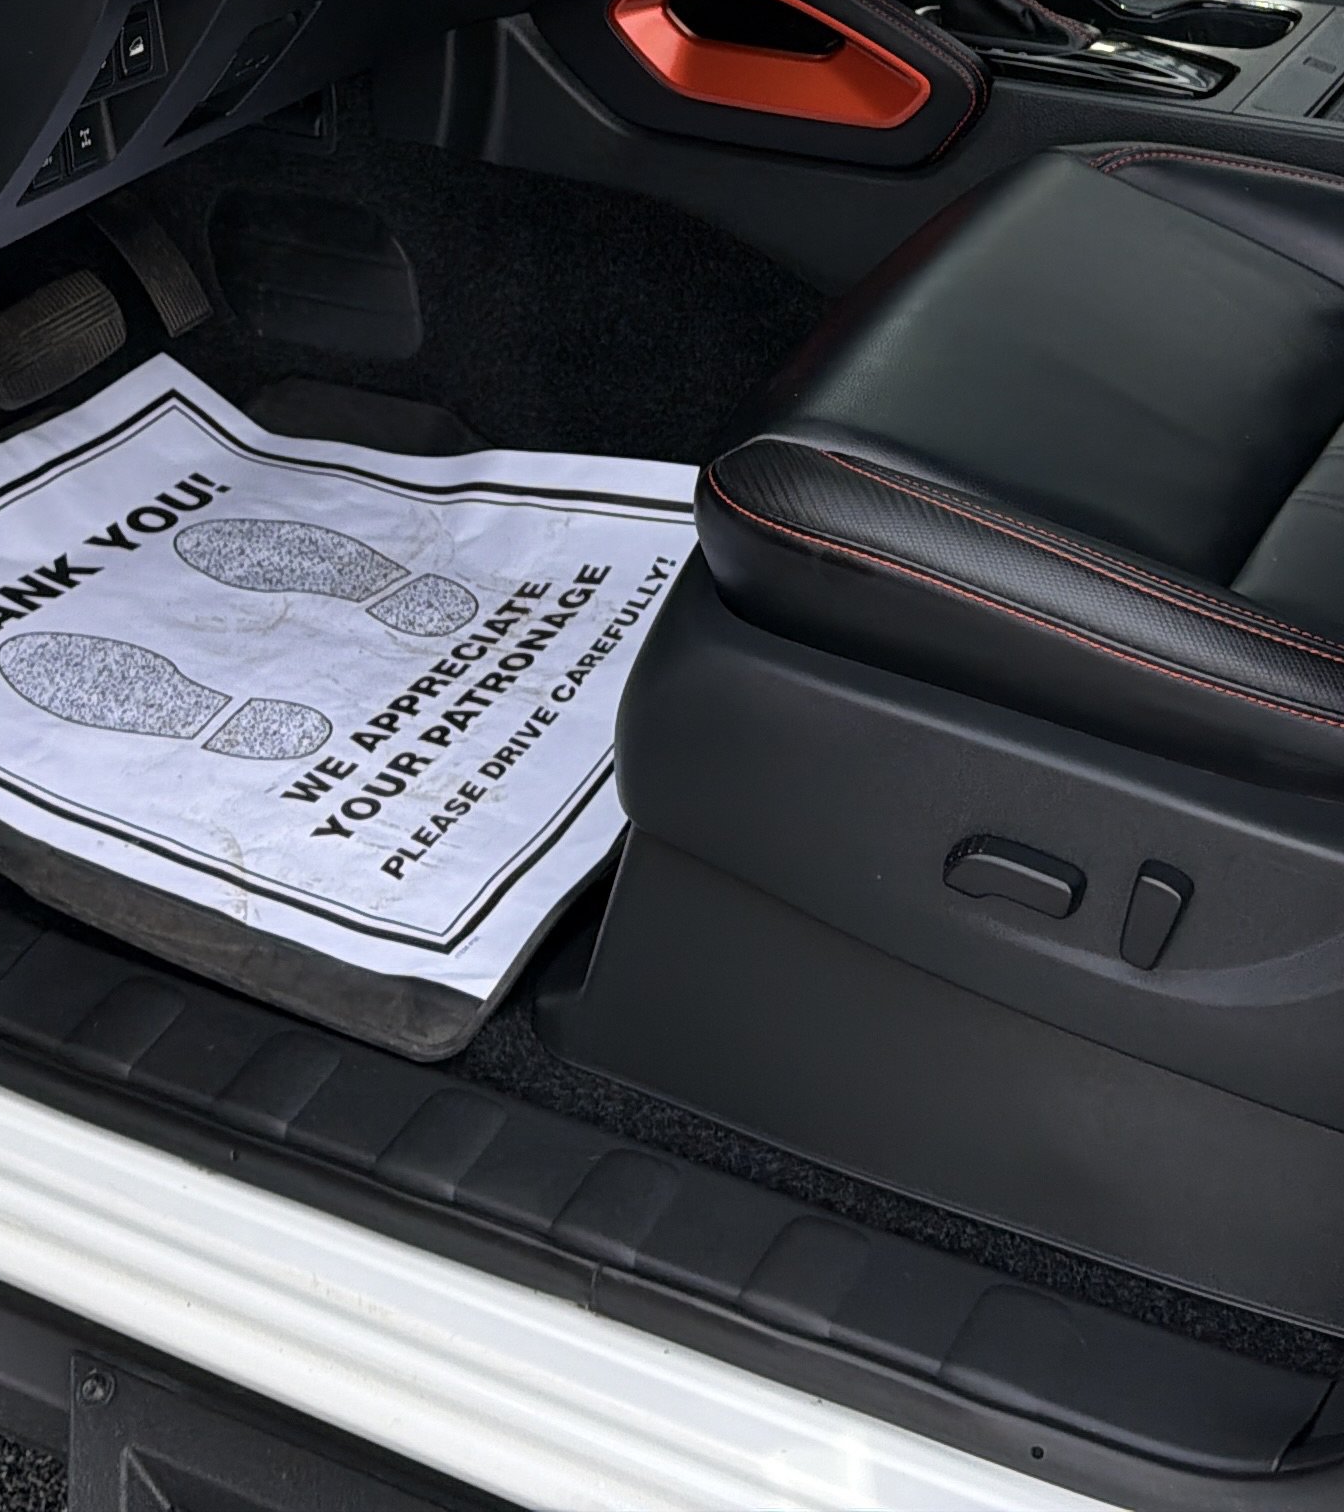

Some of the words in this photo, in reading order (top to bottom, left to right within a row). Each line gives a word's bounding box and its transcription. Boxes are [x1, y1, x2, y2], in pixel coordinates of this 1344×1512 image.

[83, 472, 232, 551] YOU!
[280, 755, 359, 805] WE
[349, 581, 552, 753] APPRECIATE
[310, 751, 433, 841] YOUR
[417, 563, 612, 749] PATRONAGE
[380, 780, 489, 881] PLEASE
[477, 705, 560, 781] DRIVE
[550, 555, 677, 705] CAREFULLY!
